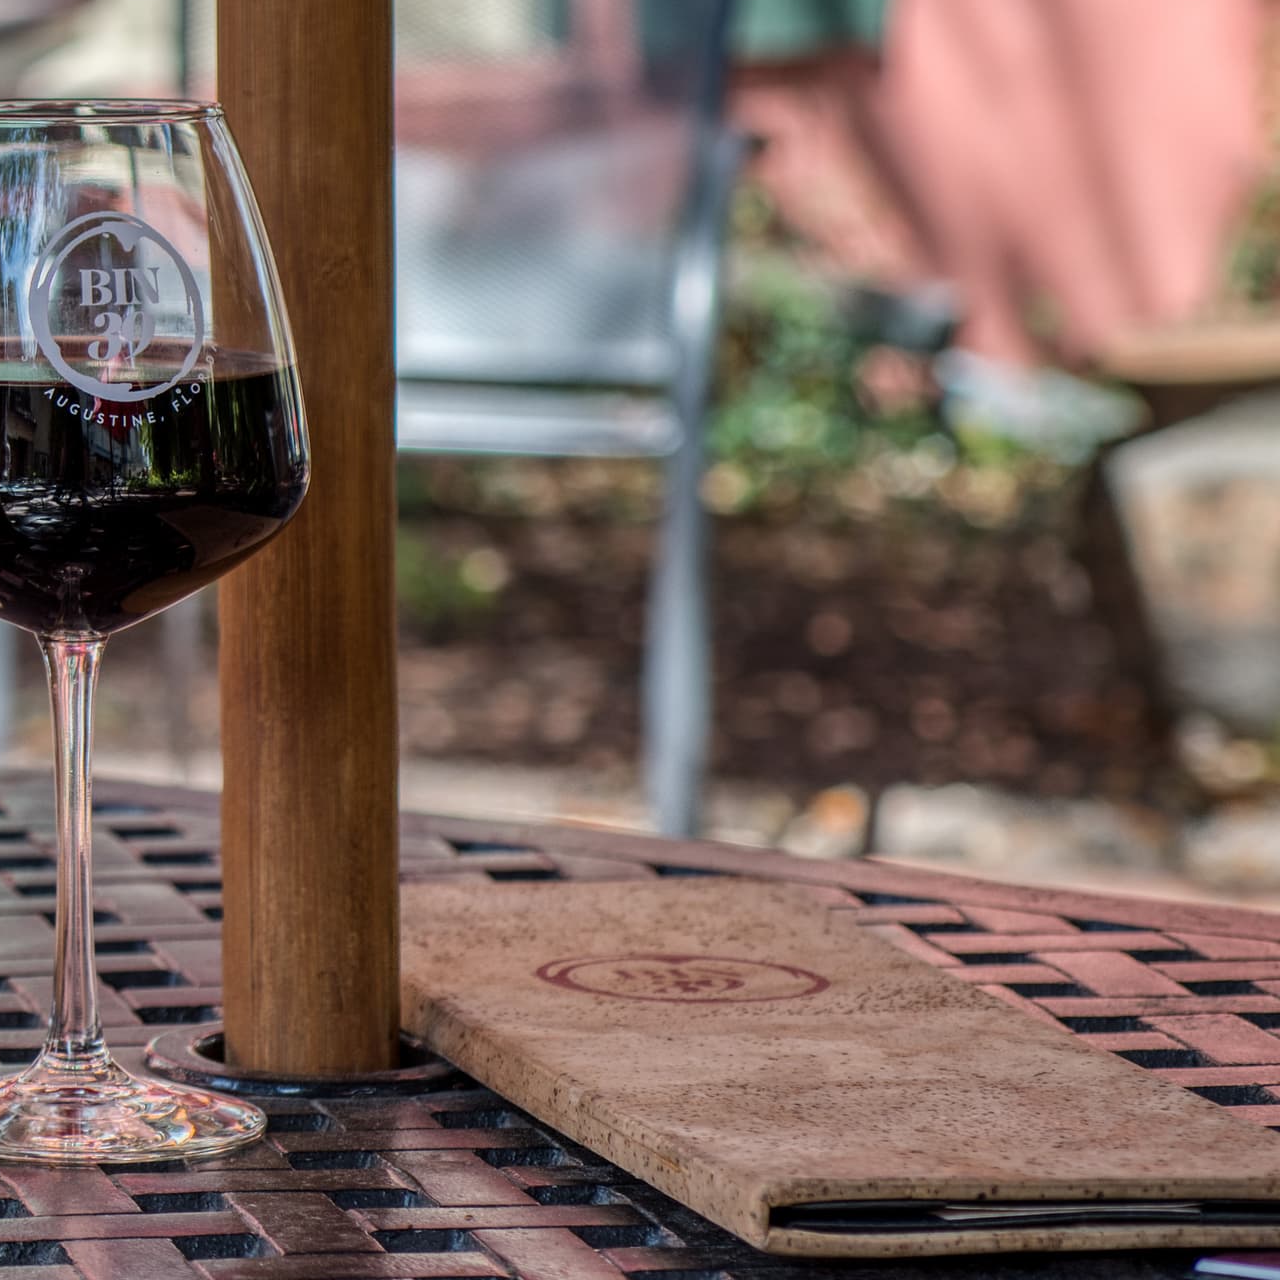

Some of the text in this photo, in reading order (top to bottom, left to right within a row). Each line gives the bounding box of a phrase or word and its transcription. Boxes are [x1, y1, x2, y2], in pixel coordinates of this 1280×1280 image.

[79, 267, 160, 307] BIN
[87, 311, 156, 361] 39
[43, 387, 165, 428] AUGUSTINE,
